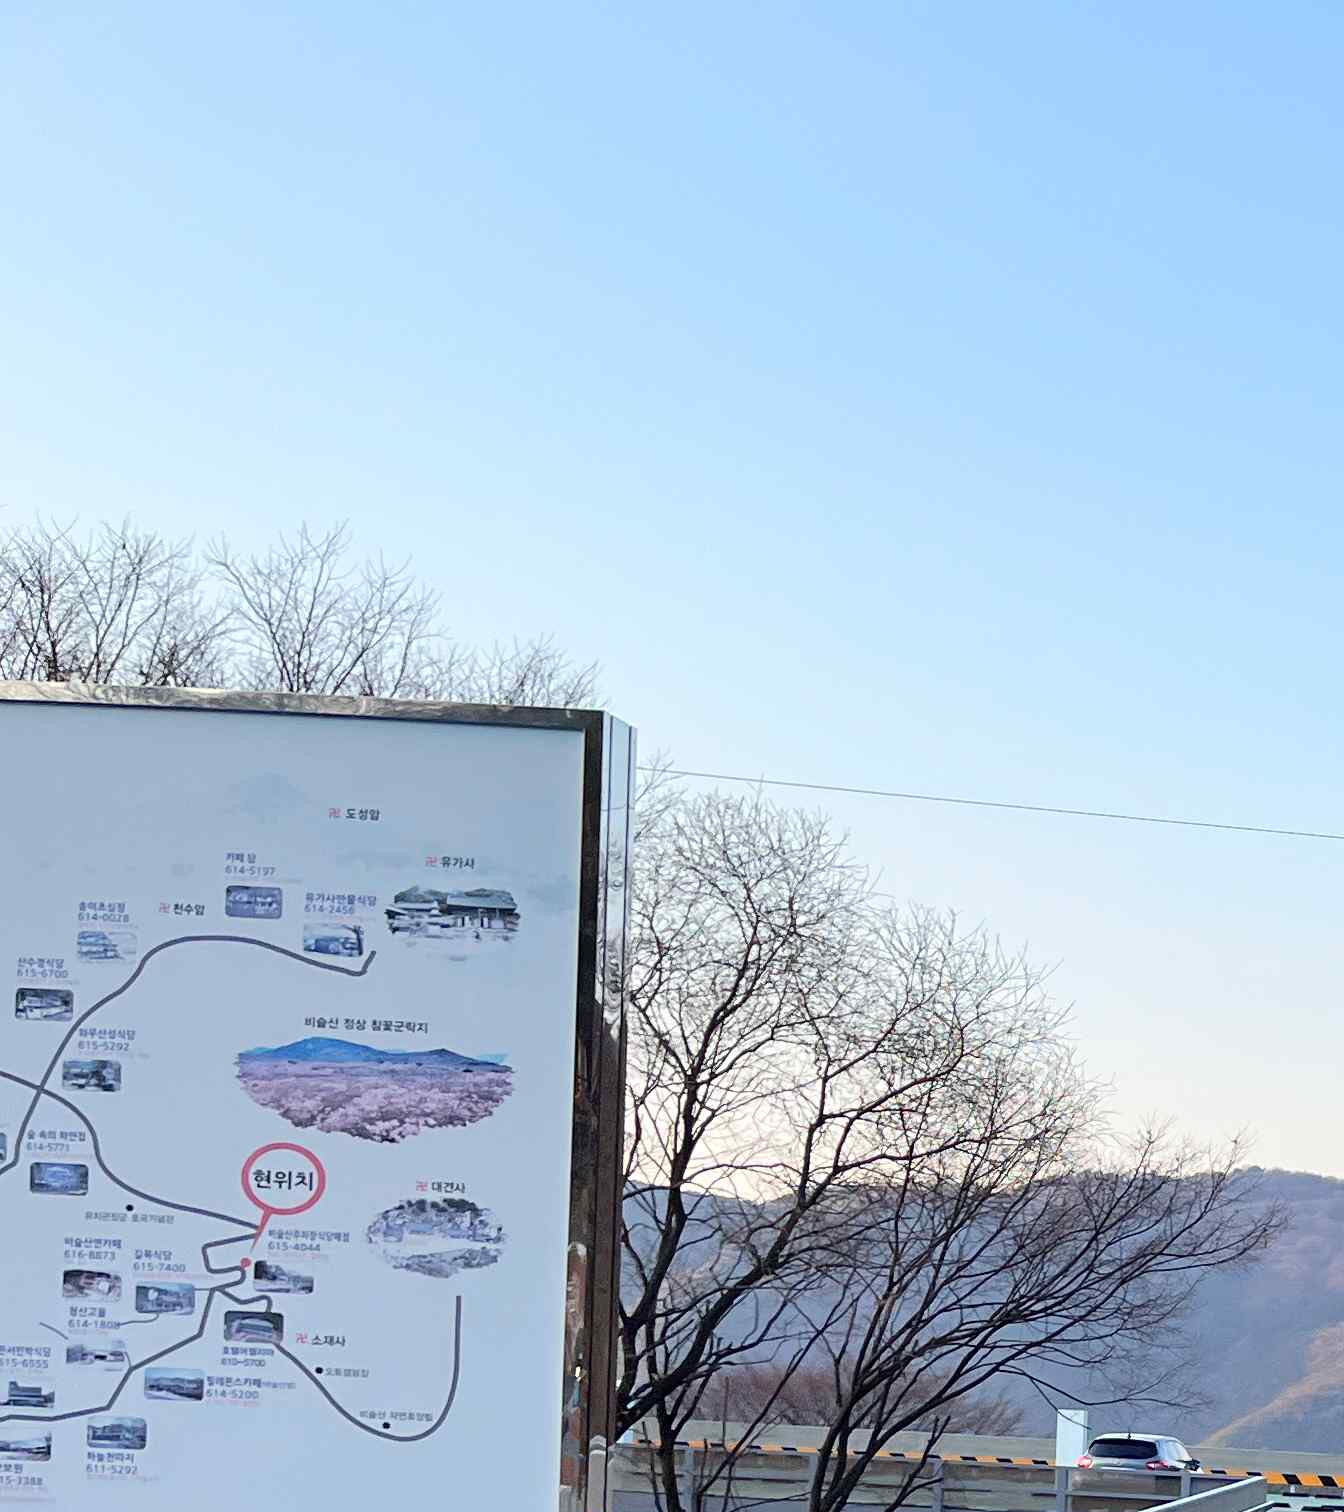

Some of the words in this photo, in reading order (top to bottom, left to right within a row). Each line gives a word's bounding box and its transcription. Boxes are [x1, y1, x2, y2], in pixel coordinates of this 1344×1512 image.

[345, 808, 380, 821] 도성암
[440, 856, 475, 870] 유가사
[304, 1016, 339, 1029] 비슬산
[343, 1018, 367, 1031] 정상
[252, 1169, 314, 1192] 현위치
[311, 1334, 346, 1347] 소재사
